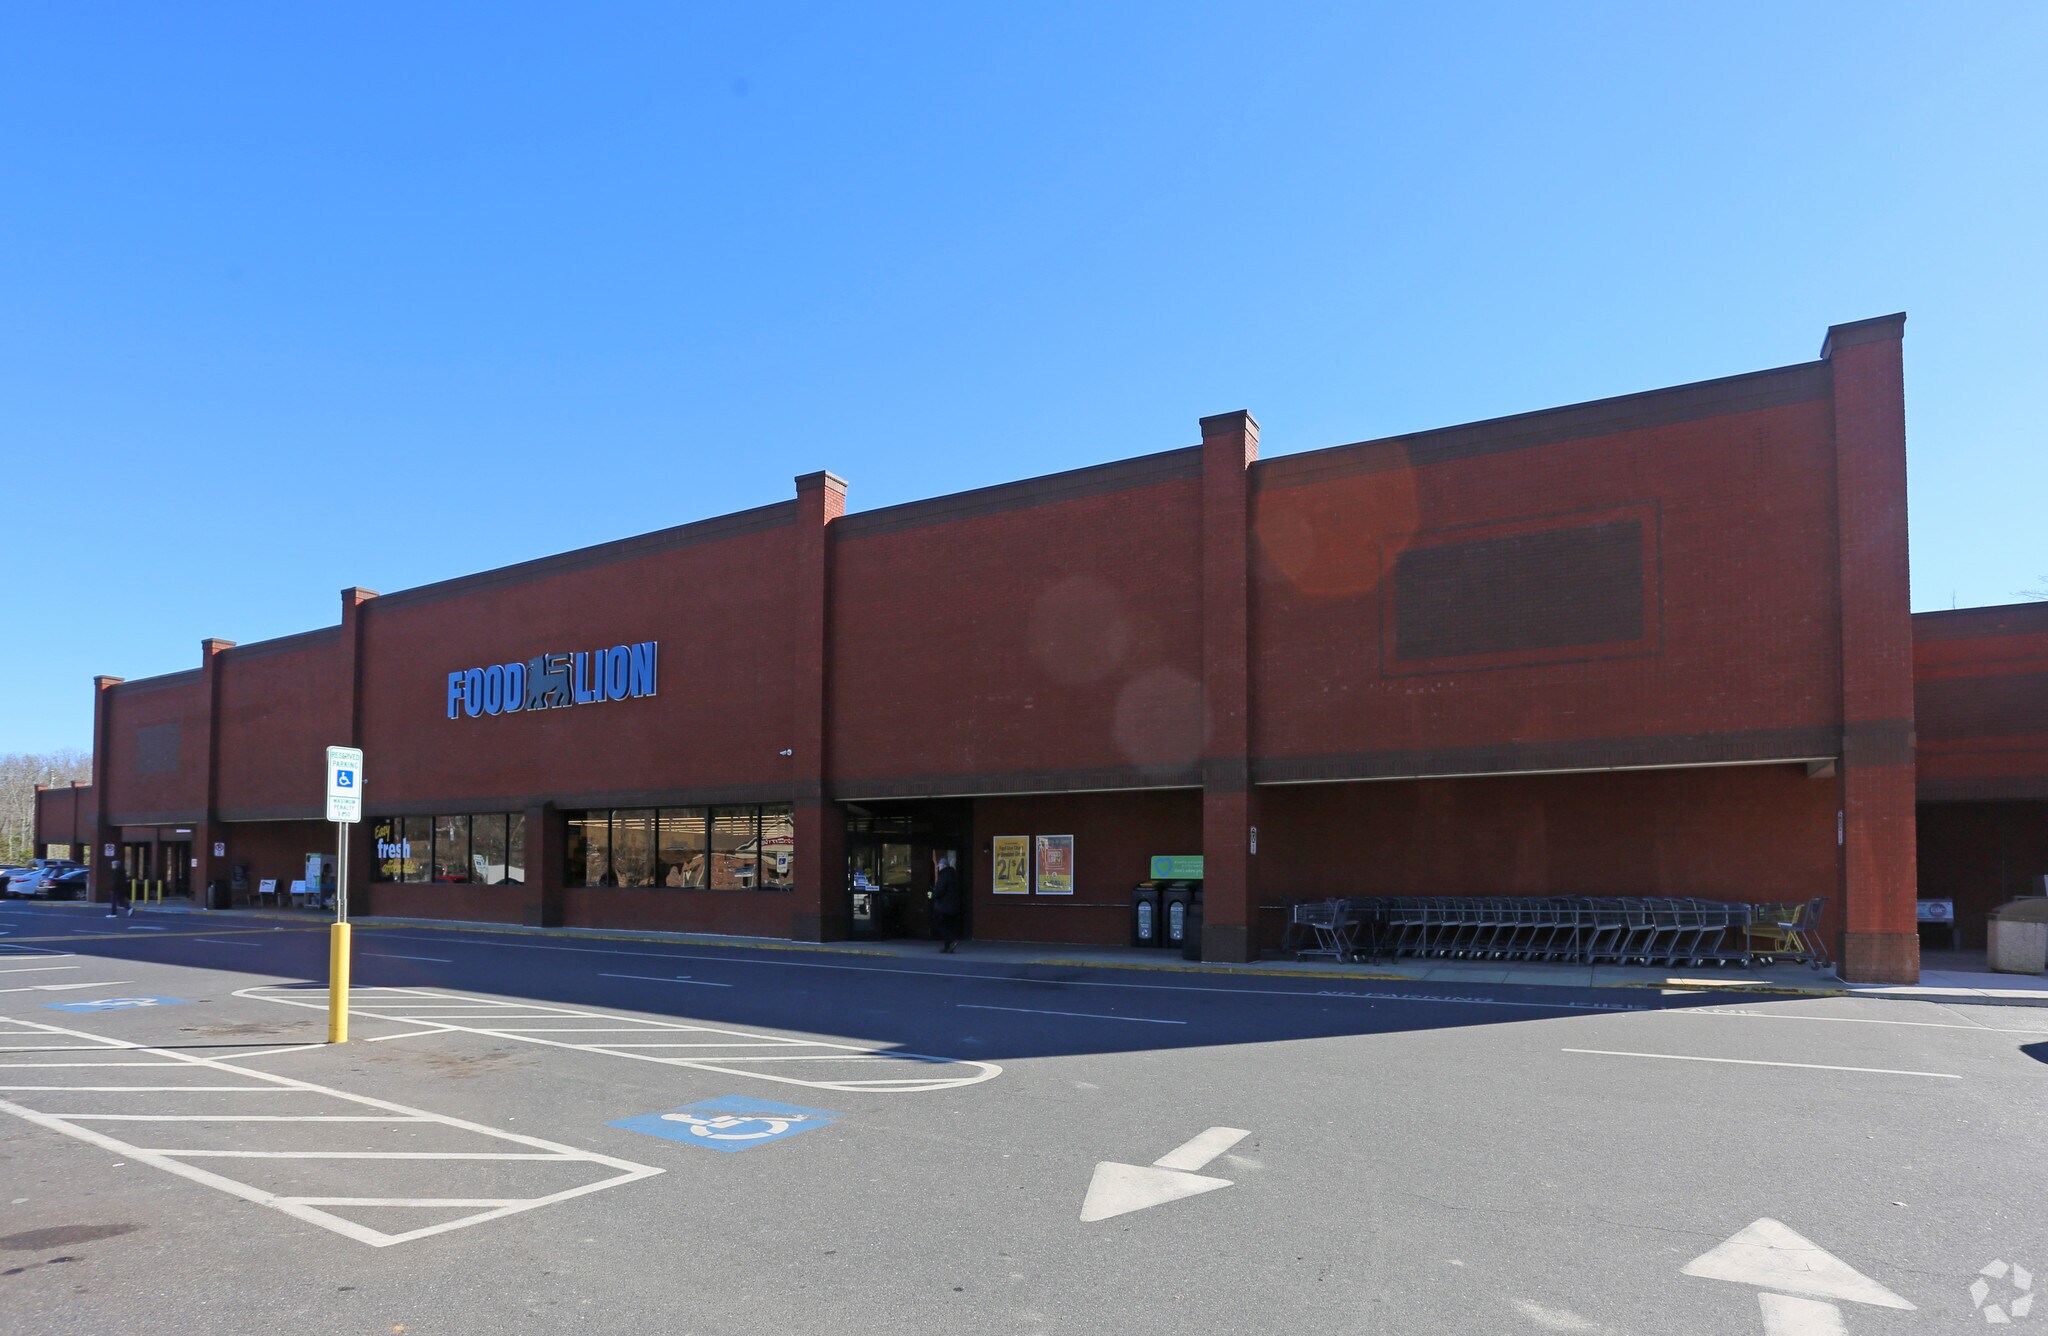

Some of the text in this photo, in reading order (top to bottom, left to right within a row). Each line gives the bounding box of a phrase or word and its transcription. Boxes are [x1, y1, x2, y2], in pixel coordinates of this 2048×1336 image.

[447, 640, 658, 720] FOOD LION
[331, 751, 360, 761] RESERVED
[332, 760, 359, 769] PARKING
[377, 837, 411, 859] fresh
[1361, 992, 1494, 1003] PARKING
